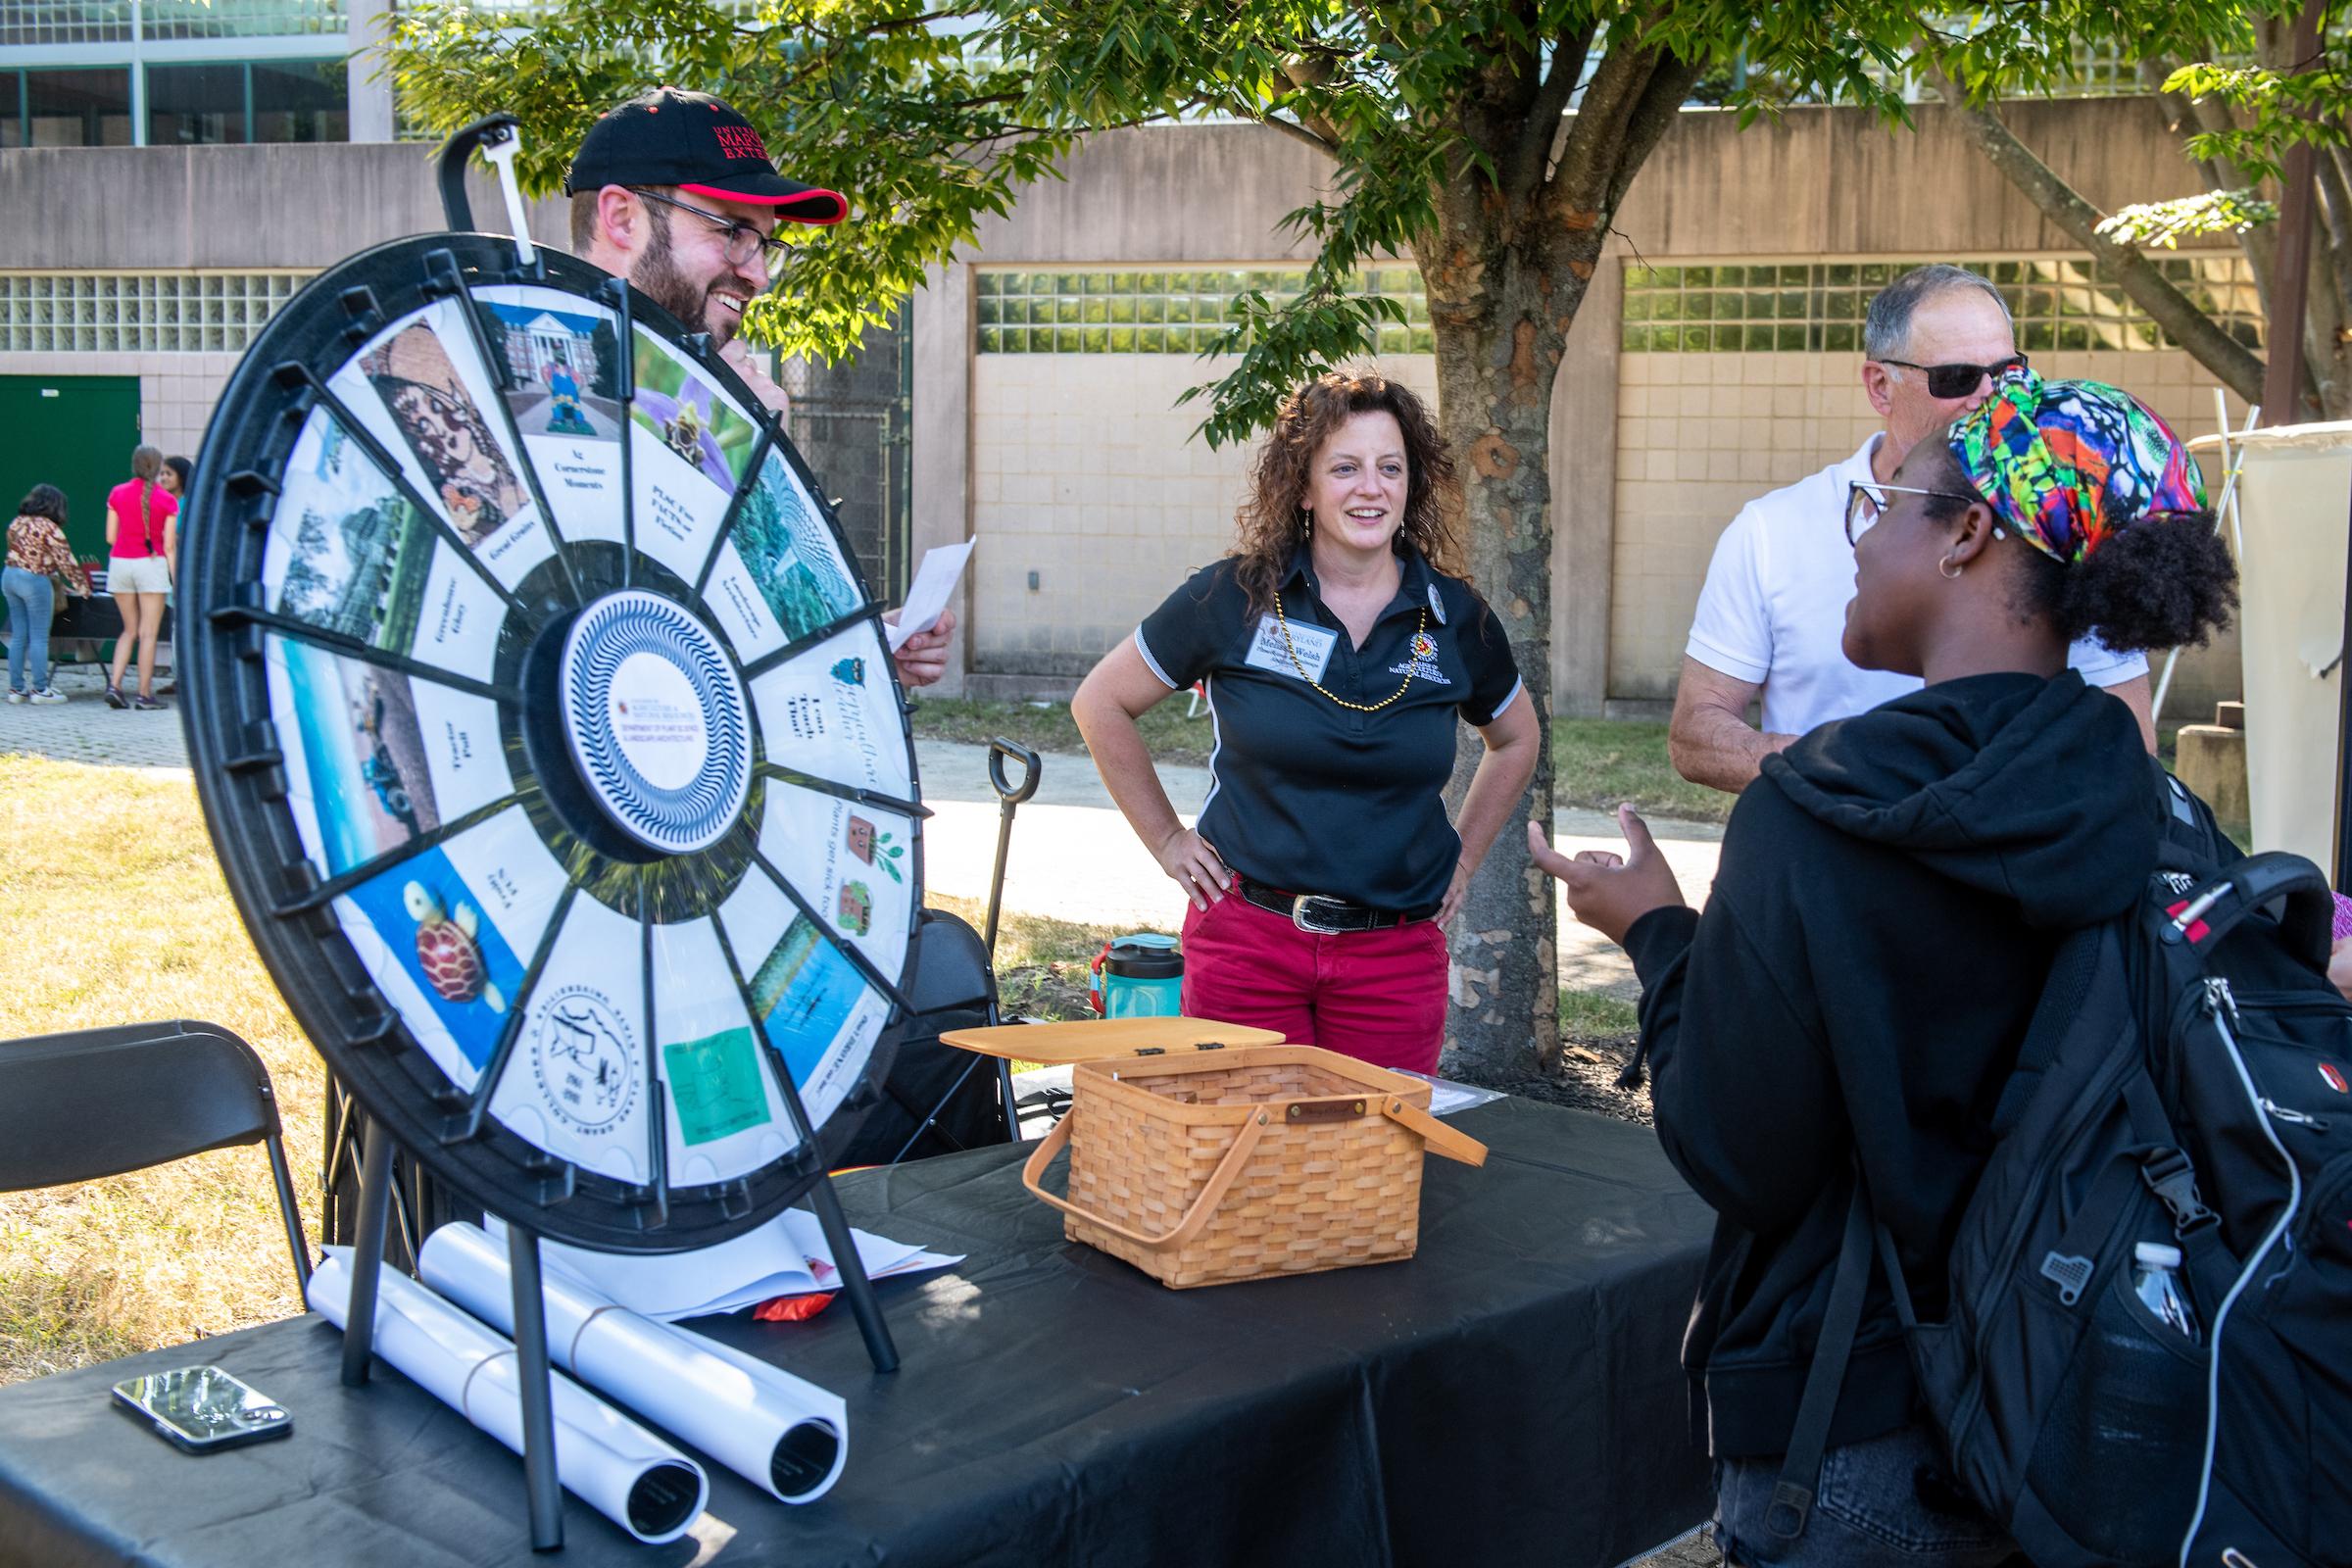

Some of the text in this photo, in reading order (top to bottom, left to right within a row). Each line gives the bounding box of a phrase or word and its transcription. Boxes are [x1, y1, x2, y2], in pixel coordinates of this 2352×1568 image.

[1296, 647, 1321, 662] Welsh
[800, 693, 814, 740] Teach
[830, 799, 843, 837] Plants
[826, 839, 837, 864] get
[824, 865, 836, 891] sick
